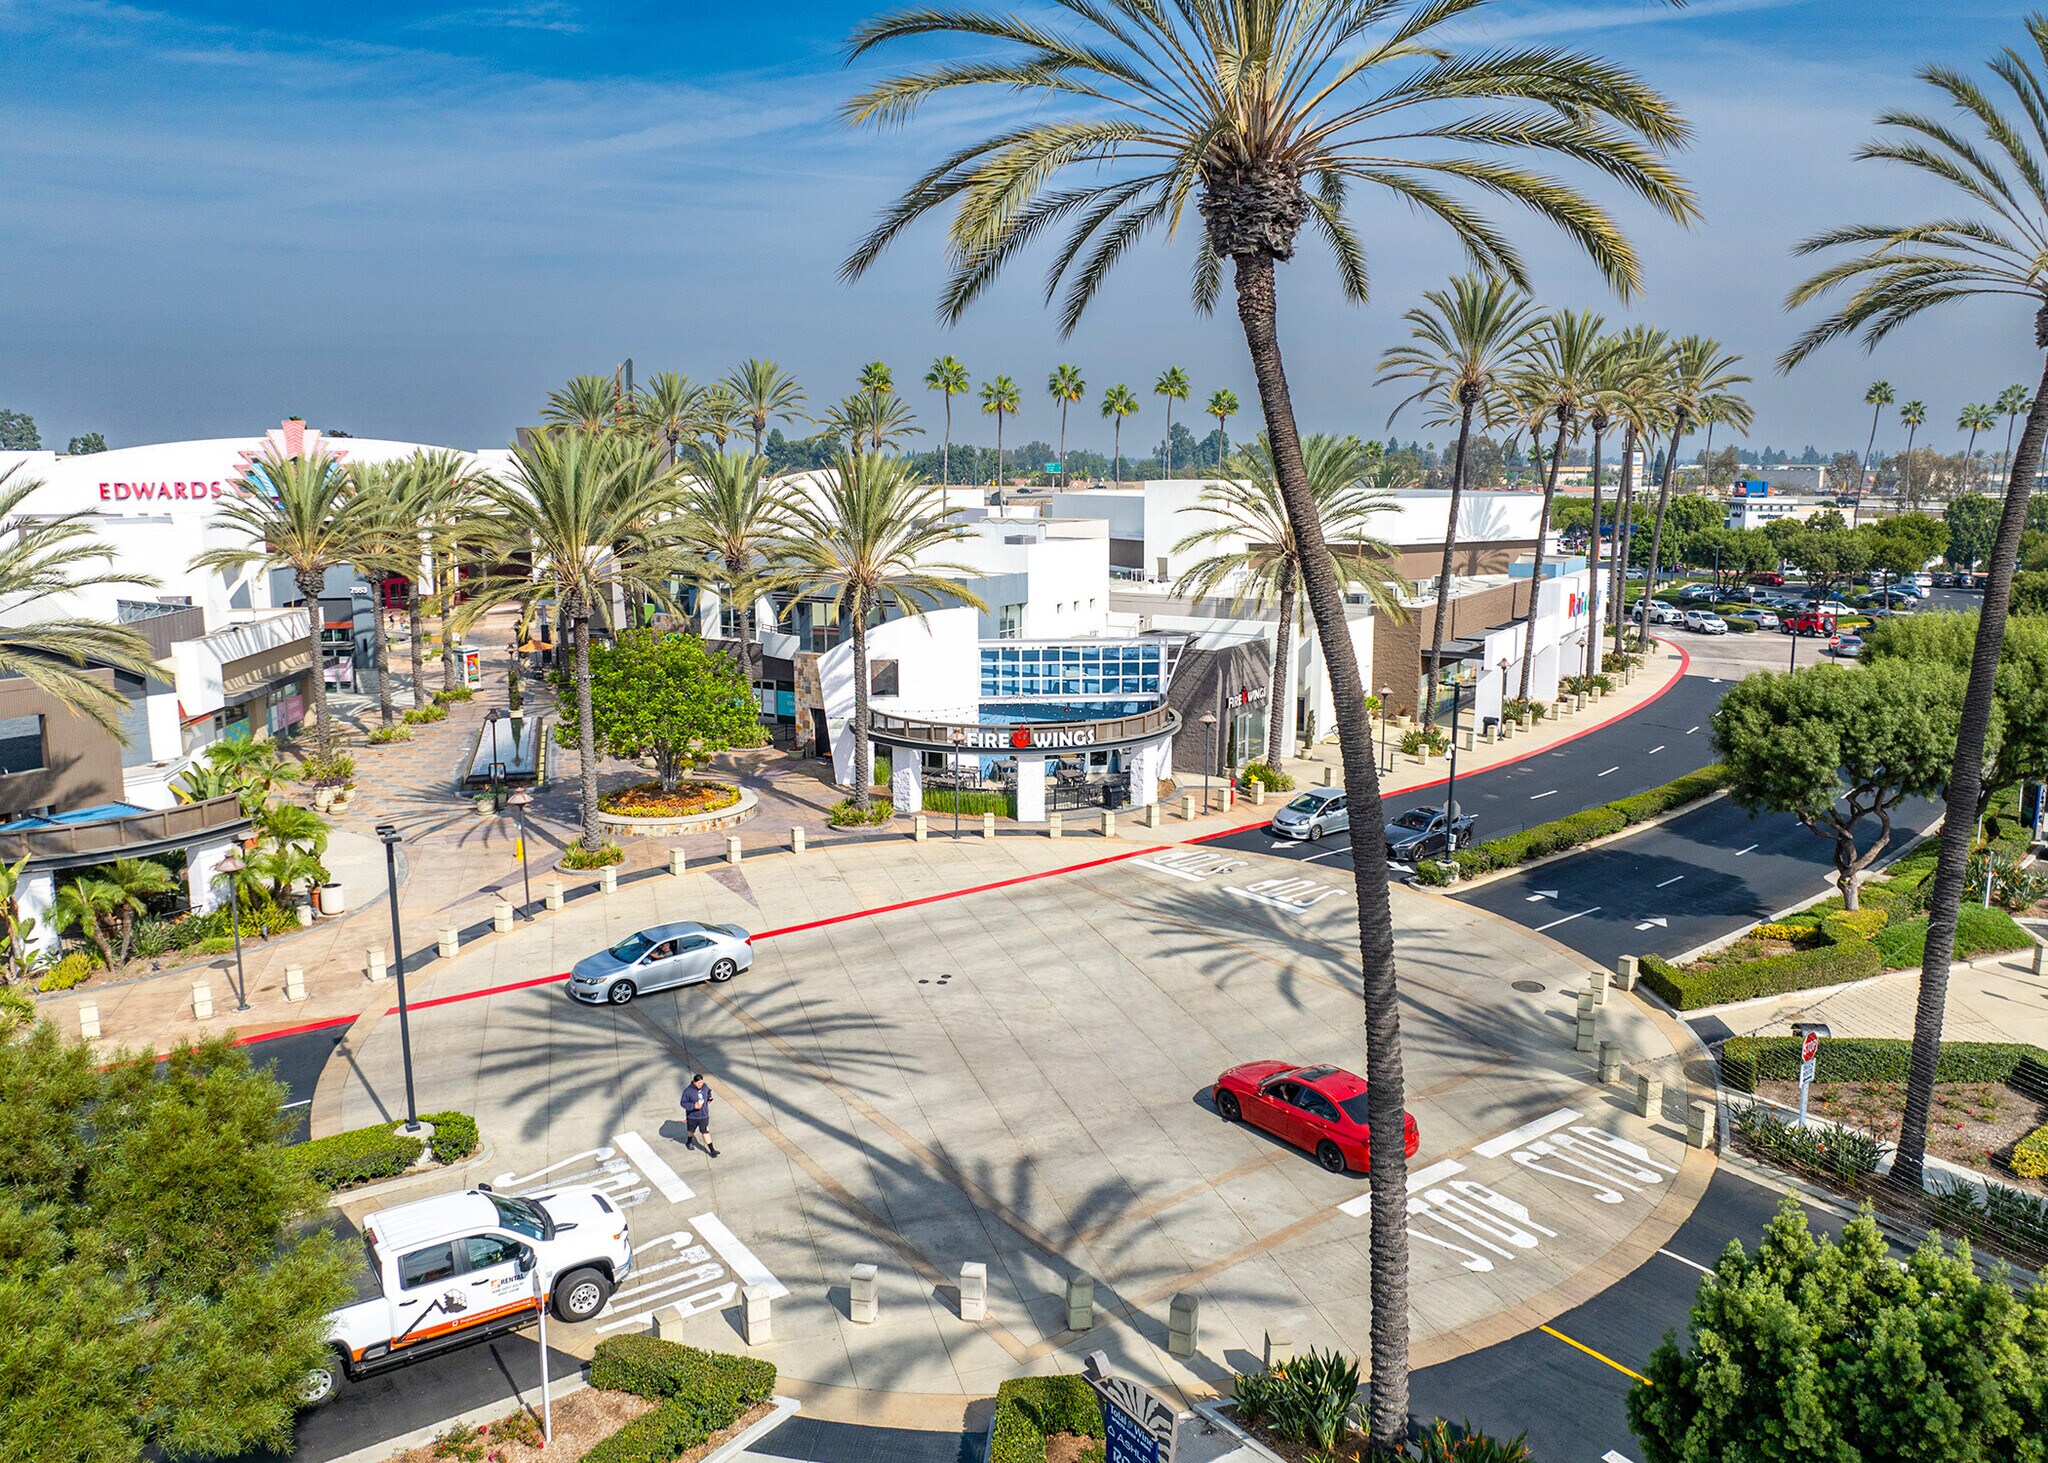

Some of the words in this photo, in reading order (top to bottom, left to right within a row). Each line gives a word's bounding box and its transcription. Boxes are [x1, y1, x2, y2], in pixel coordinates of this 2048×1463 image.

[99, 481, 222, 500] EDWARDS
[966, 732, 1010, 749] FIRE
[1033, 729, 1095, 749] WINGS
[1246, 877, 1348, 907] STOP
[1511, 1126, 1679, 1204] STOP
[1406, 1180, 1558, 1273] STOP
[501, 1273, 524, 1285] RENTAL
[1109, 1403, 1126, 1426] Total
[1134, 1425, 1154, 1449] Wine
